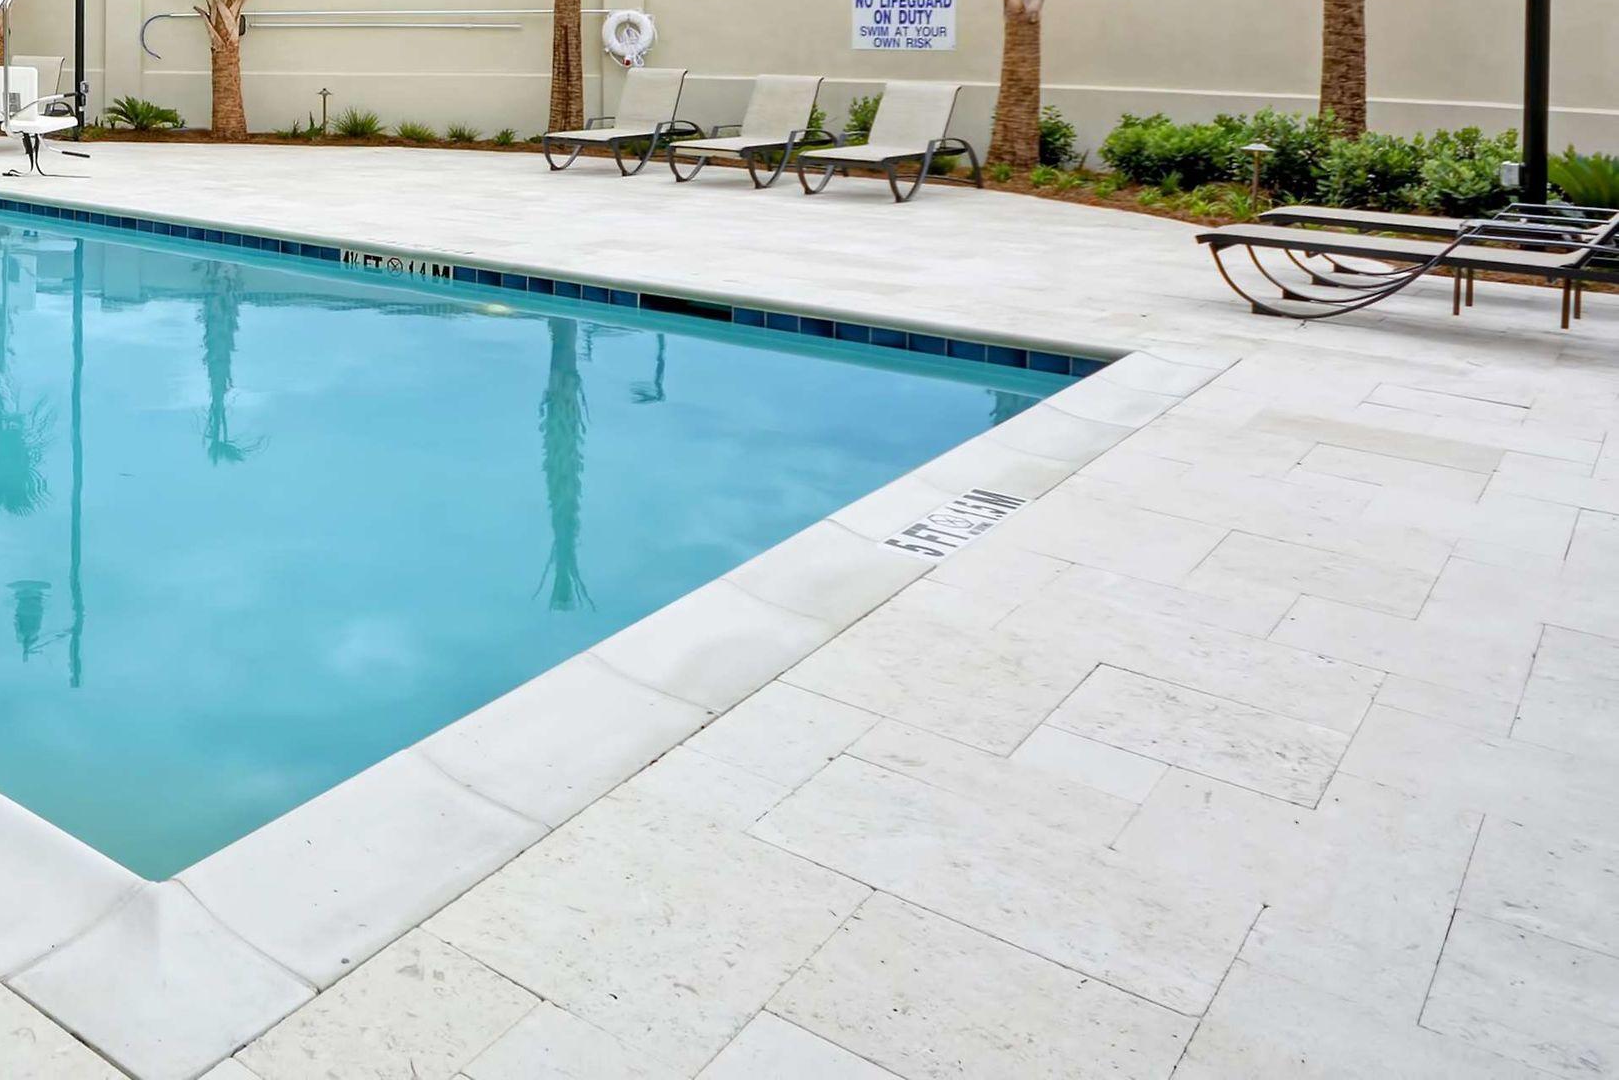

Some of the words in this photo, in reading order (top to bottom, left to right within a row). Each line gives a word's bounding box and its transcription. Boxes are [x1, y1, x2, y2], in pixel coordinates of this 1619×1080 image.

[874, 9, 892, 25] ON
[899, 9, 932, 25] DUTY
[860, 25, 889, 37] SWIM
[894, 26, 909, 37] AT
[915, 26, 947, 37] YOUR
[873, 37, 900, 48] OWN
[906, 37, 932, 48] RISK
[363, 254, 383, 268] FT
[432, 263, 450, 278] M
[962, 489, 1027, 510] M
[901, 523, 969, 548] FT
[884, 539, 944, 557] 5
